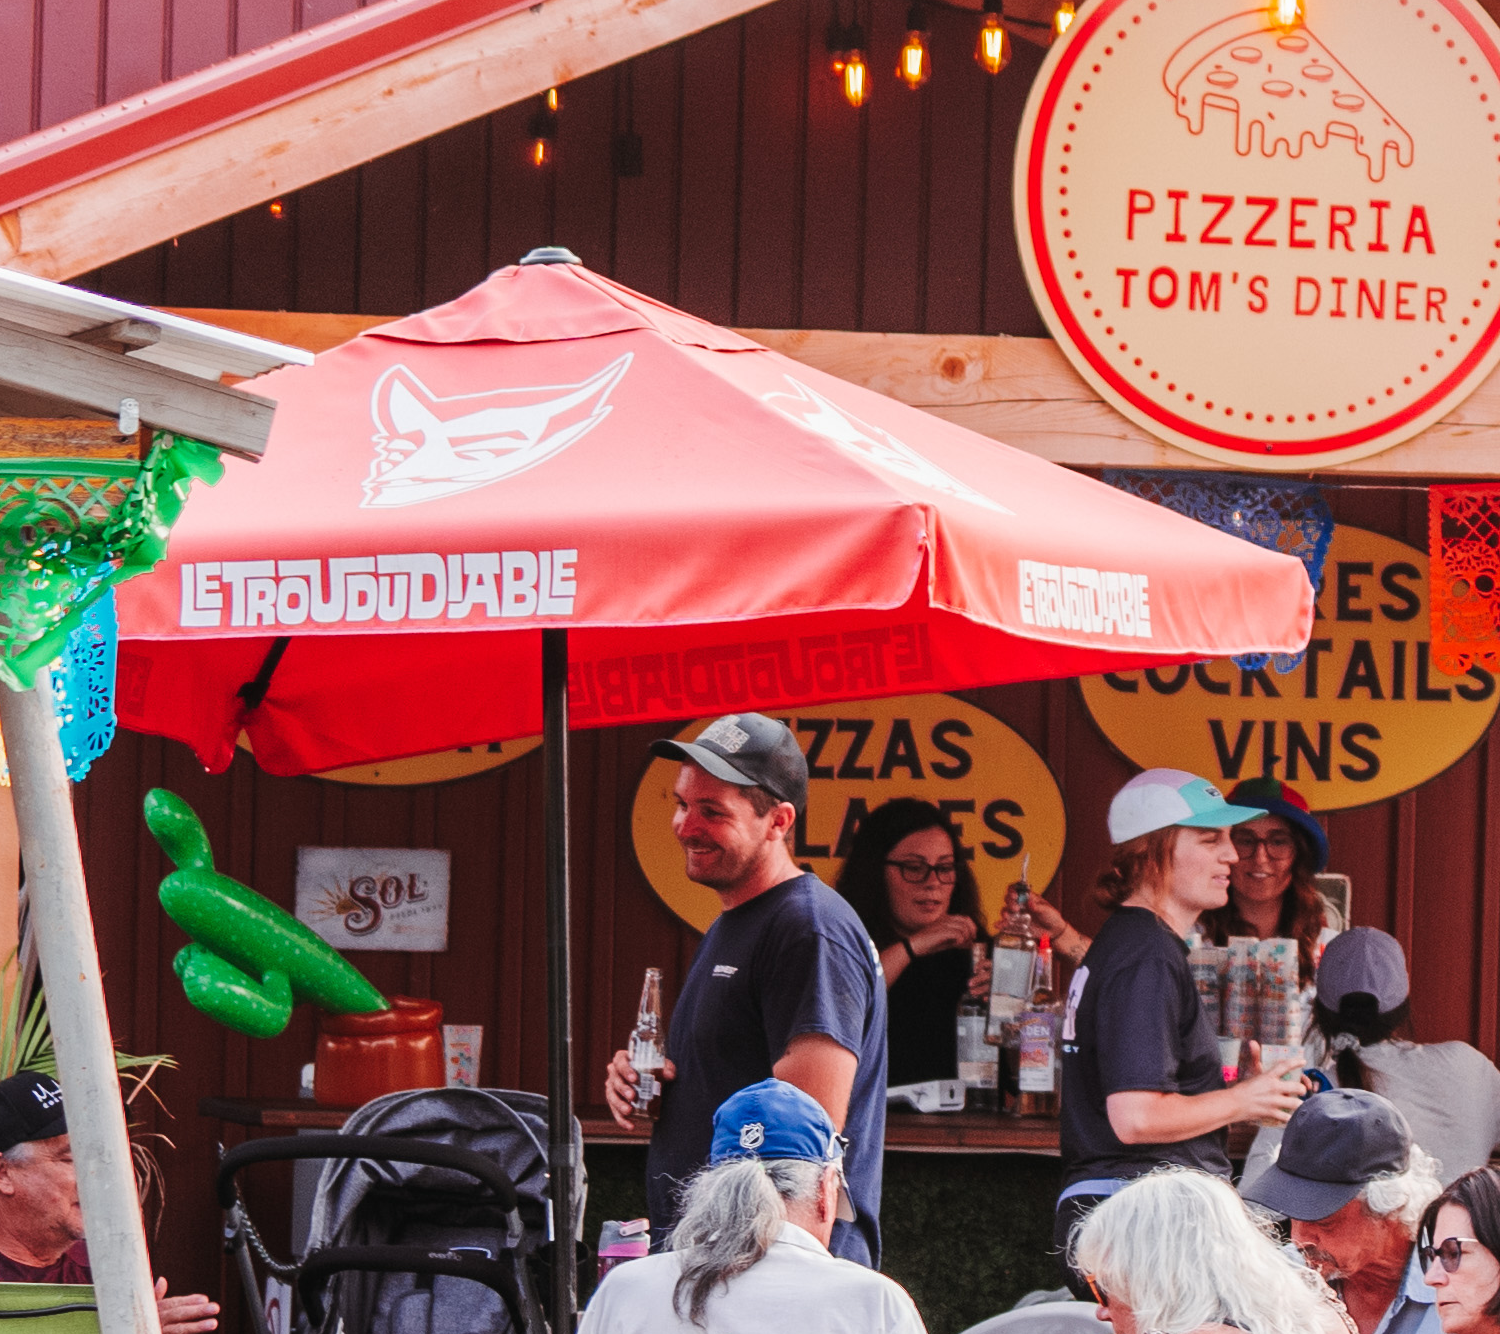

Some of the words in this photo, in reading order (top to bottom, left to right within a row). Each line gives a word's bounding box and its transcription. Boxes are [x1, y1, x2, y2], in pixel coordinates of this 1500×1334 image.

[1125, 188, 1436, 256] PIZZERIA
[1114, 267, 1270, 314] TOM'S
[1294, 276, 1448, 324] DINER
[786, 717, 974, 780] ZZAS
[1207, 718, 1382, 782] VINS
[344, 872, 429, 936] SOL
